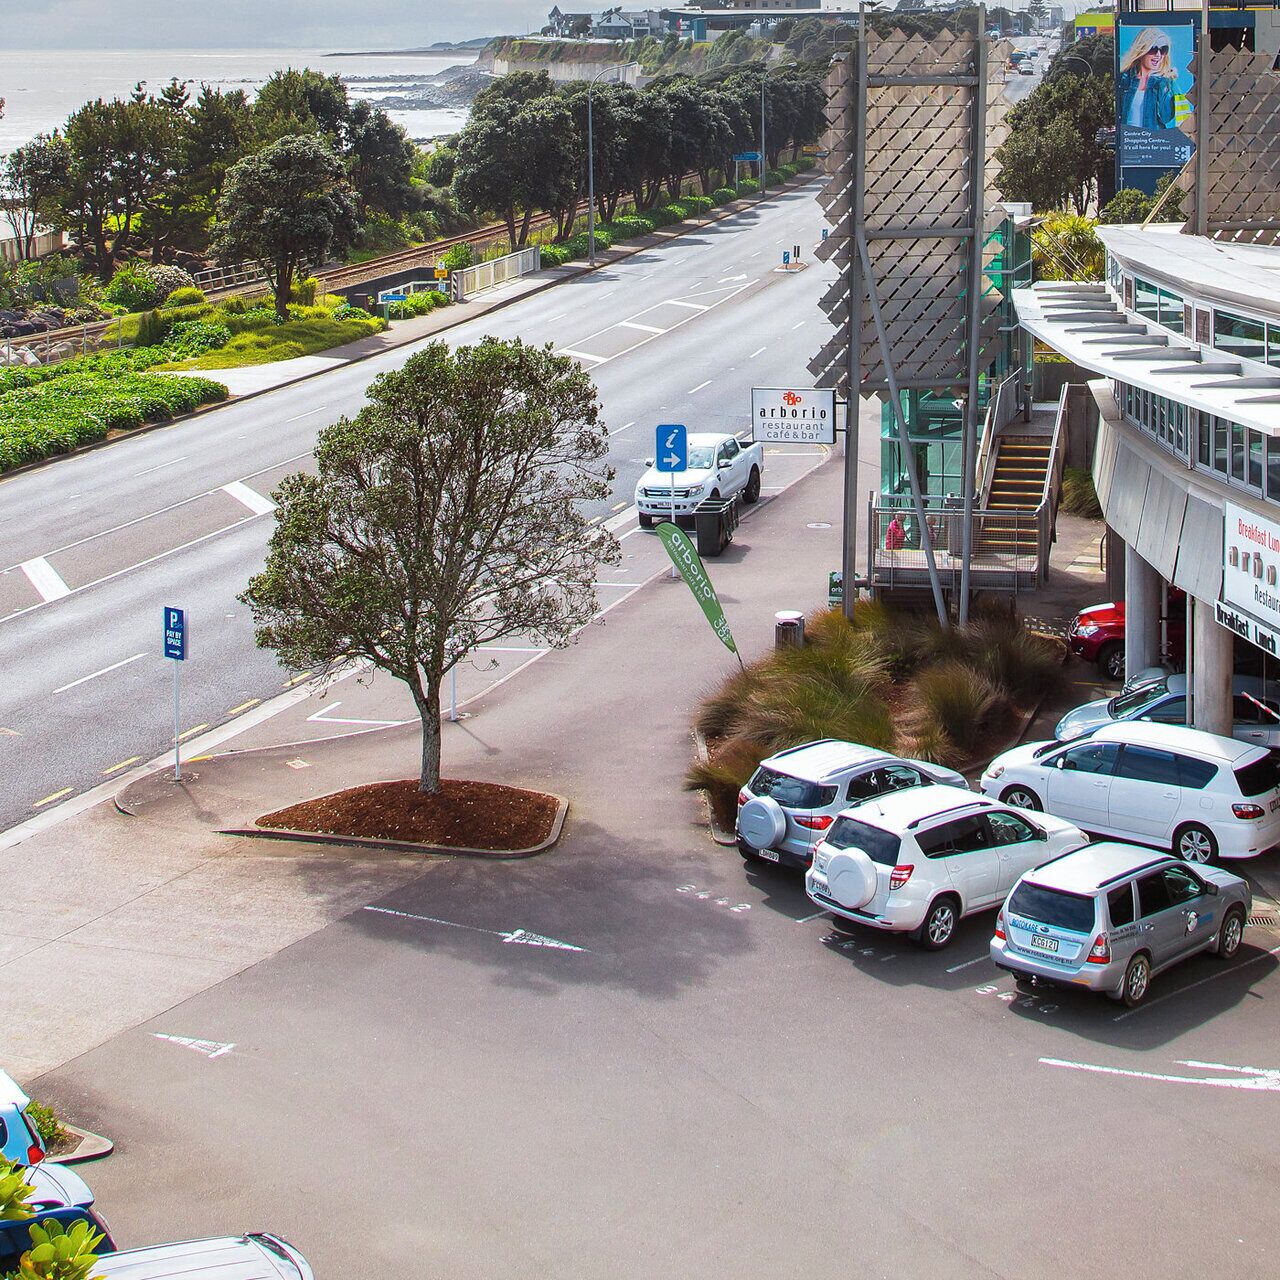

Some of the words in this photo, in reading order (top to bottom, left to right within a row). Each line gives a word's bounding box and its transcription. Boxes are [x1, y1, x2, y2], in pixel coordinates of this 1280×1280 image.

[759, 406, 826, 419] arborio
[762, 421, 824, 431] restaurant
[766, 430, 790, 439] café
[801, 431, 820, 439] bar
[1238, 517, 1267, 546] Breakfast
[667, 540, 688, 573] RESTAURANT
[671, 532, 713, 598] arborio
[170, 611, 179, 628] P
[166, 630, 175, 638] PAY
[175, 631, 182, 640] BY
[1216, 603, 1250, 640] Breakfast
[1254, 625, 1276, 655] Lunch
[167, 637, 182, 646] SPACE
[1032, 935, 1058, 951] KCG121
